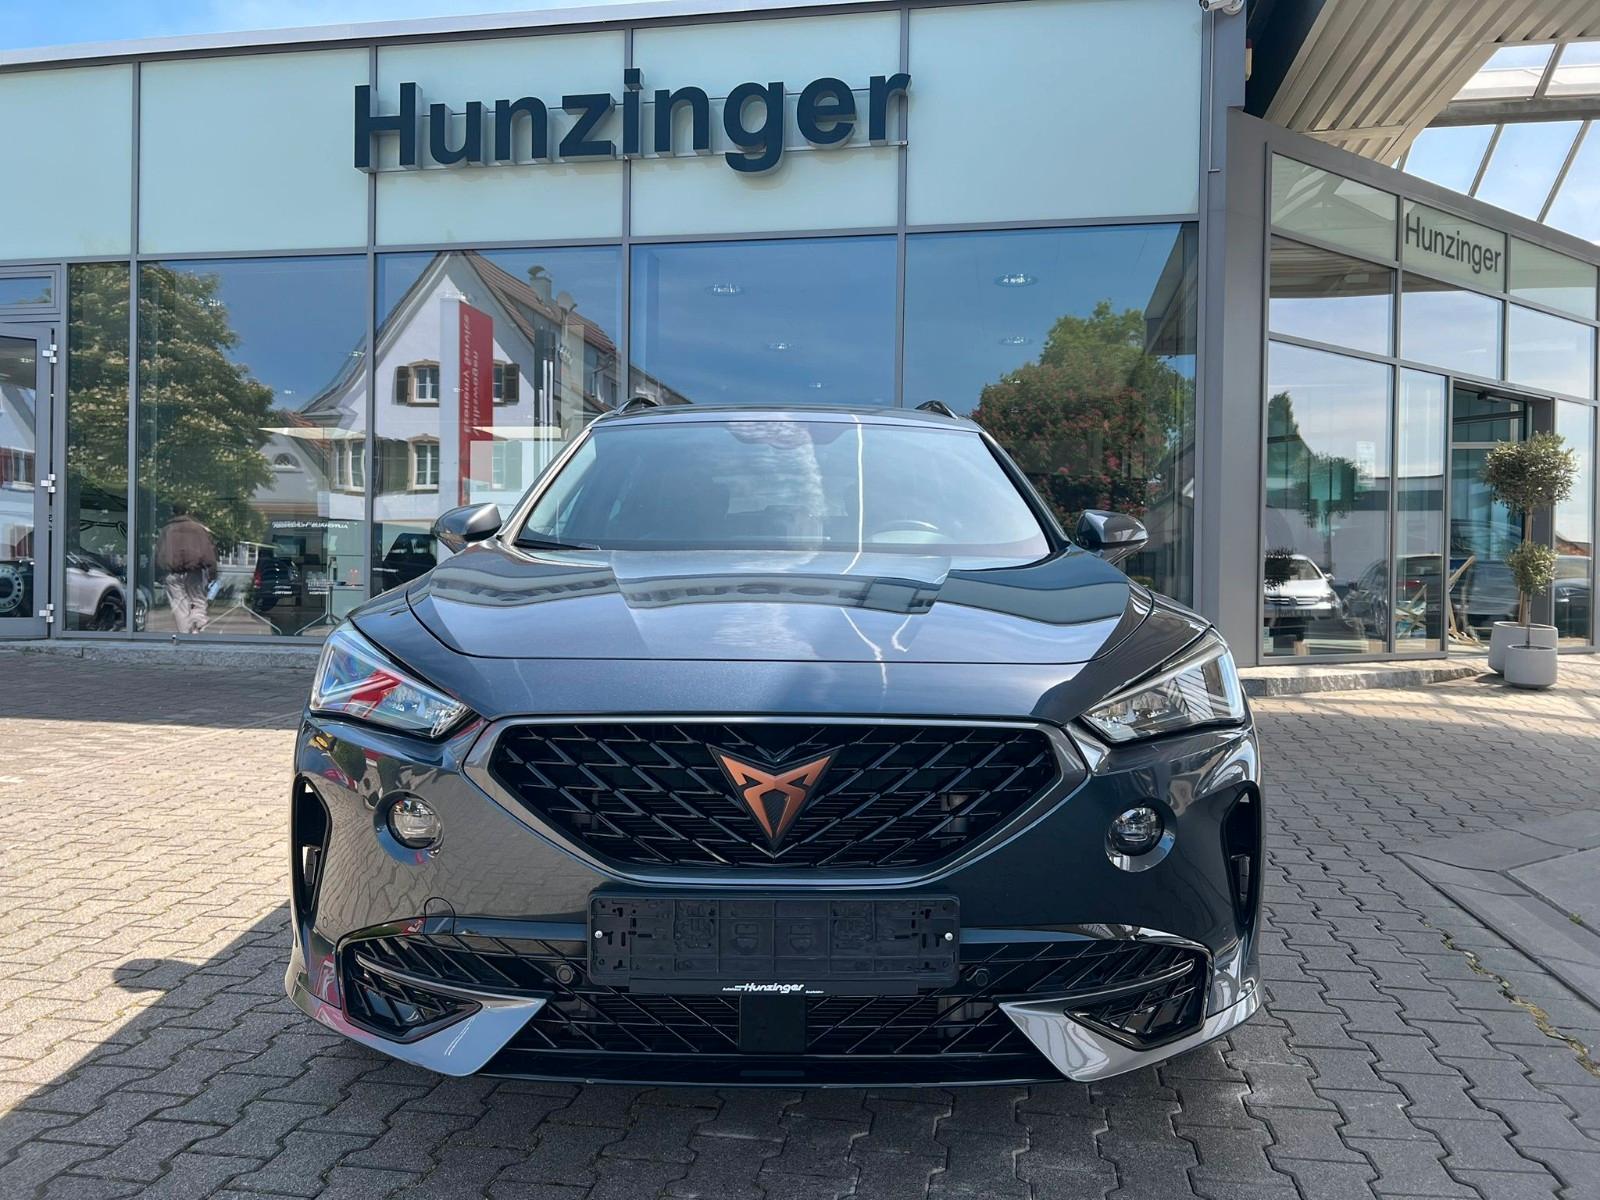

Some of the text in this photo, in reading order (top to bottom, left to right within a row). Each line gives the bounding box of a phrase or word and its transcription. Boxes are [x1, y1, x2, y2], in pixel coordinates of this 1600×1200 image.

[354, 68, 912, 173] Hunzinger
[1405, 212, 1502, 274] Hunzinger
[735, 982, 805, 994] Hunzinger
